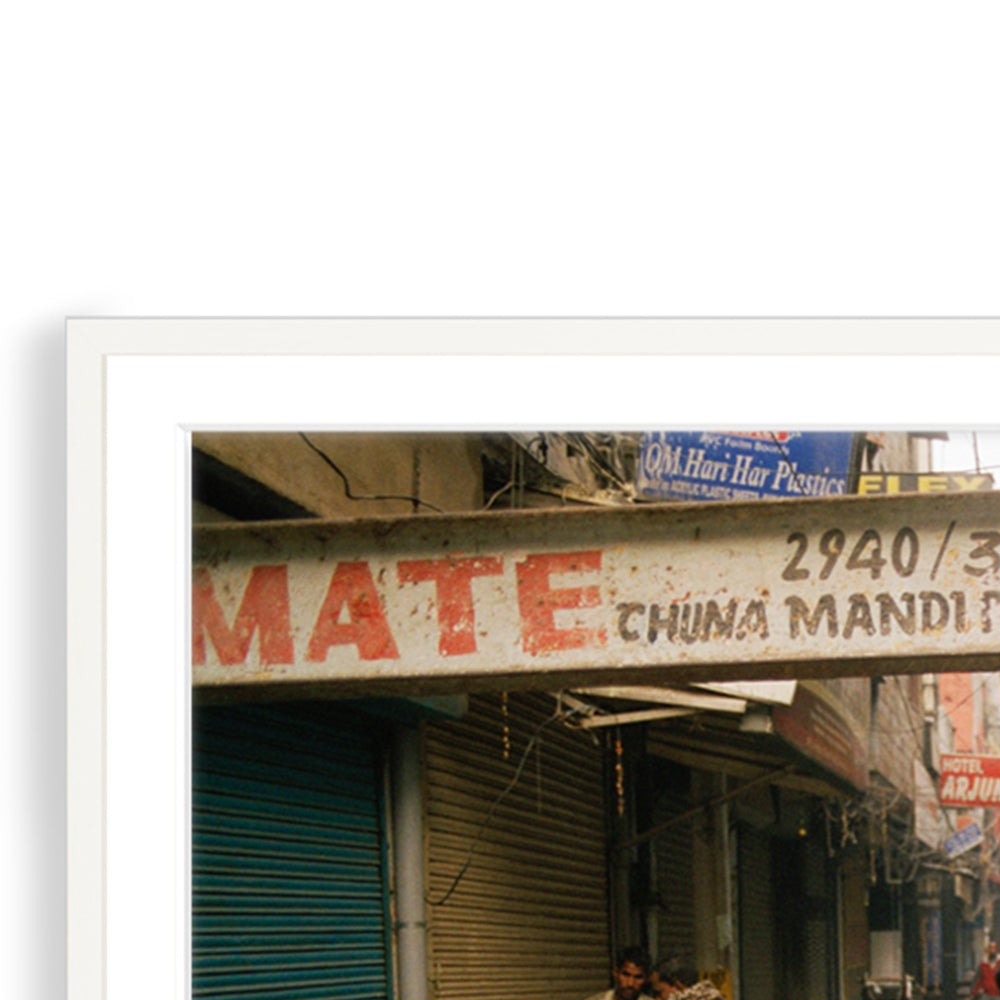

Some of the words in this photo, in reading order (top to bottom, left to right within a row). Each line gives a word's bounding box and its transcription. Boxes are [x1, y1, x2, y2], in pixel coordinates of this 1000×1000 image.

[684, 448, 730, 482] Hari
[730, 454, 771, 487] Har
[192, 551, 607, 667] MATE
[616, 599, 770, 644] CHUNA
[785, 591, 967, 640] MANDI
[943, 758, 984, 774] HOTEL
